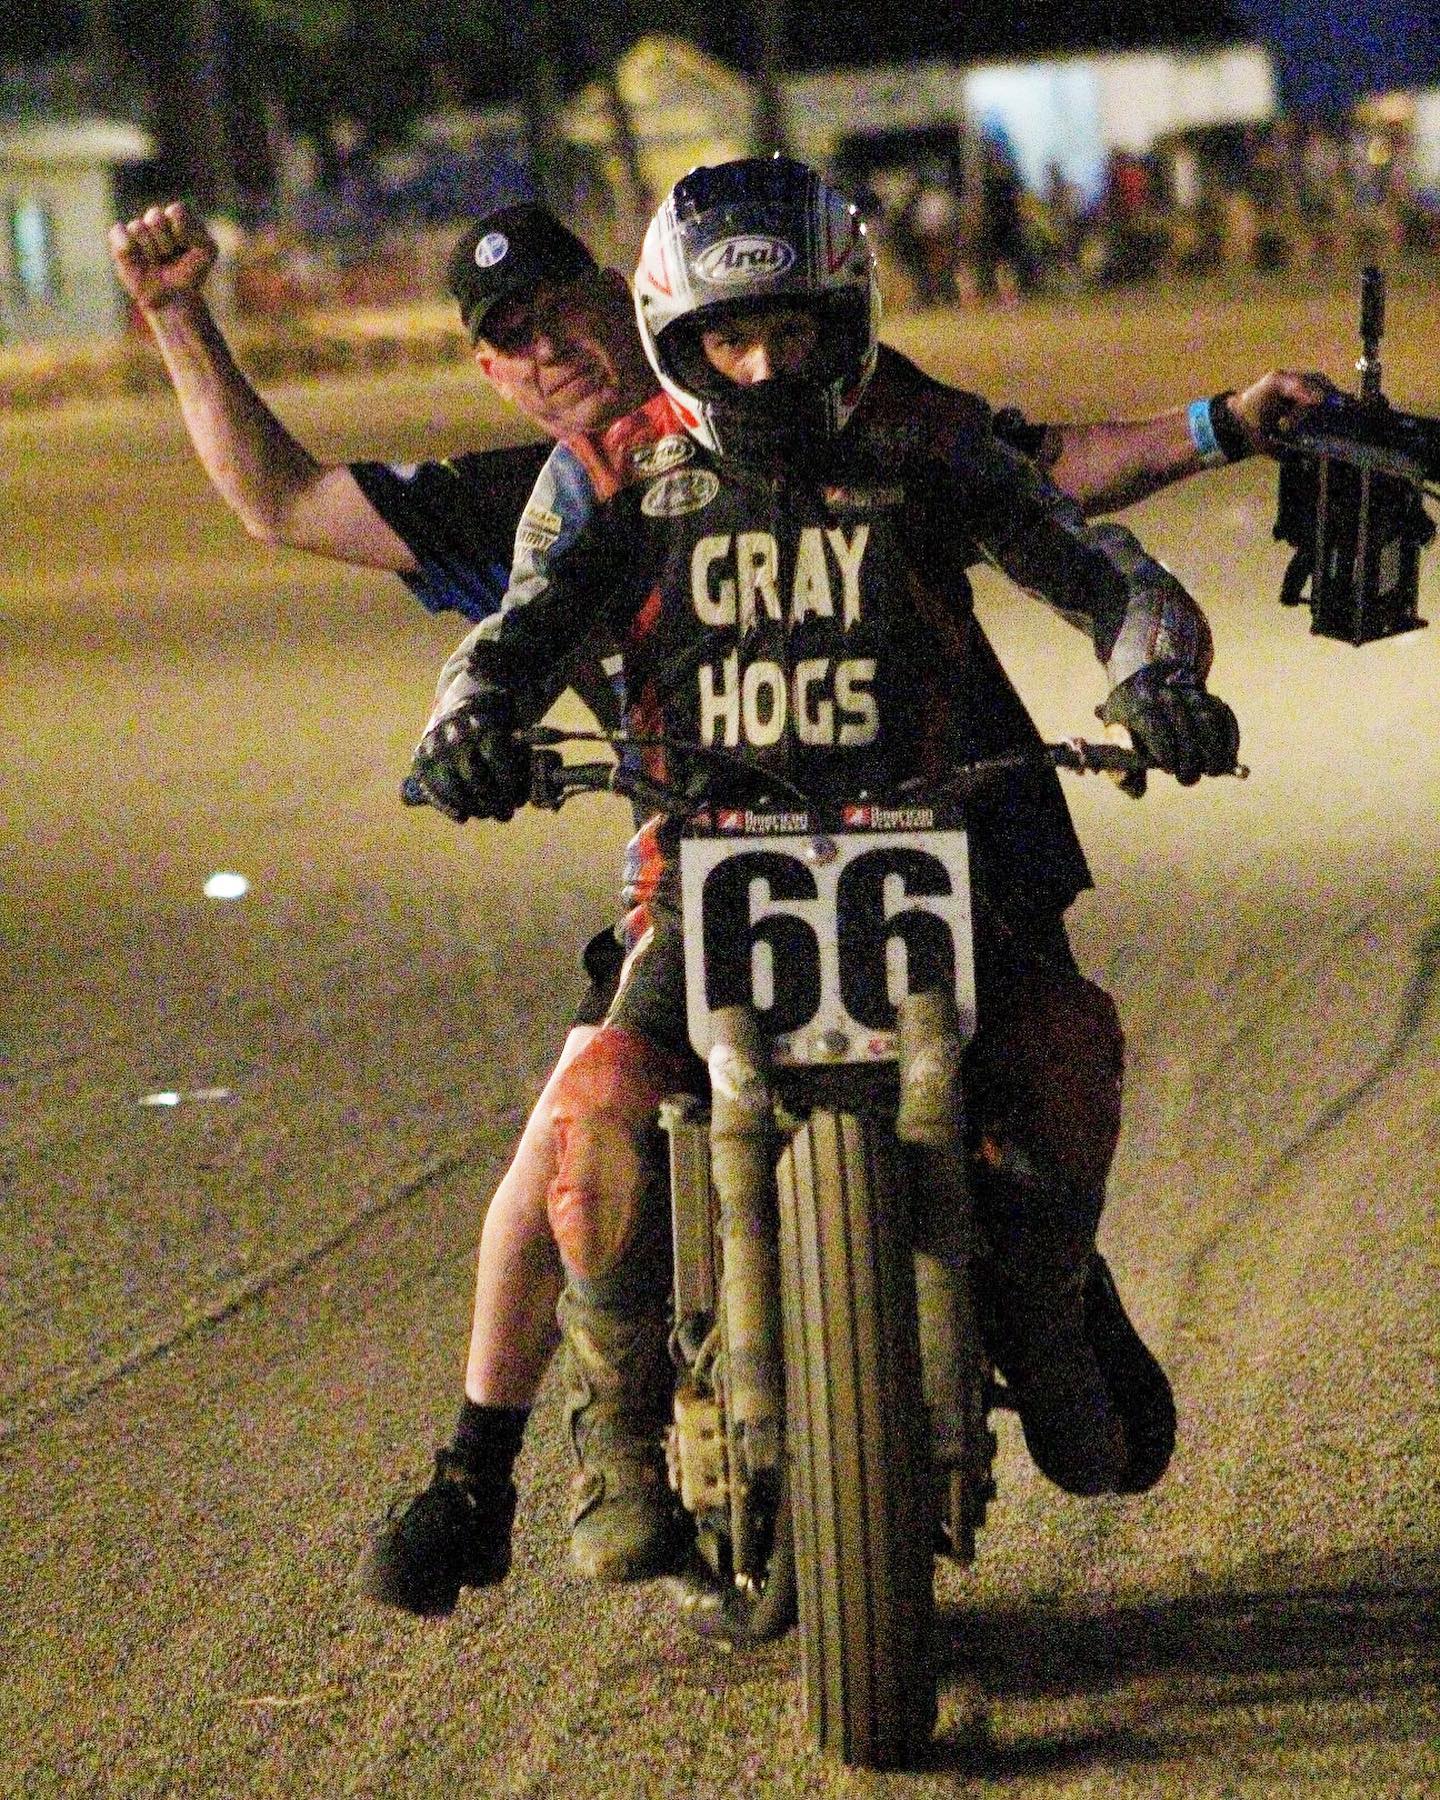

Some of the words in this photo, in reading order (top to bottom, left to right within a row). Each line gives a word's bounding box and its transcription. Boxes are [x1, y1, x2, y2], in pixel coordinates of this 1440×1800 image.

[710, 241, 781, 270] Arai
[690, 524, 870, 637] GRAY
[698, 649, 880, 747] HOGS
[702, 847, 957, 1034] 66
